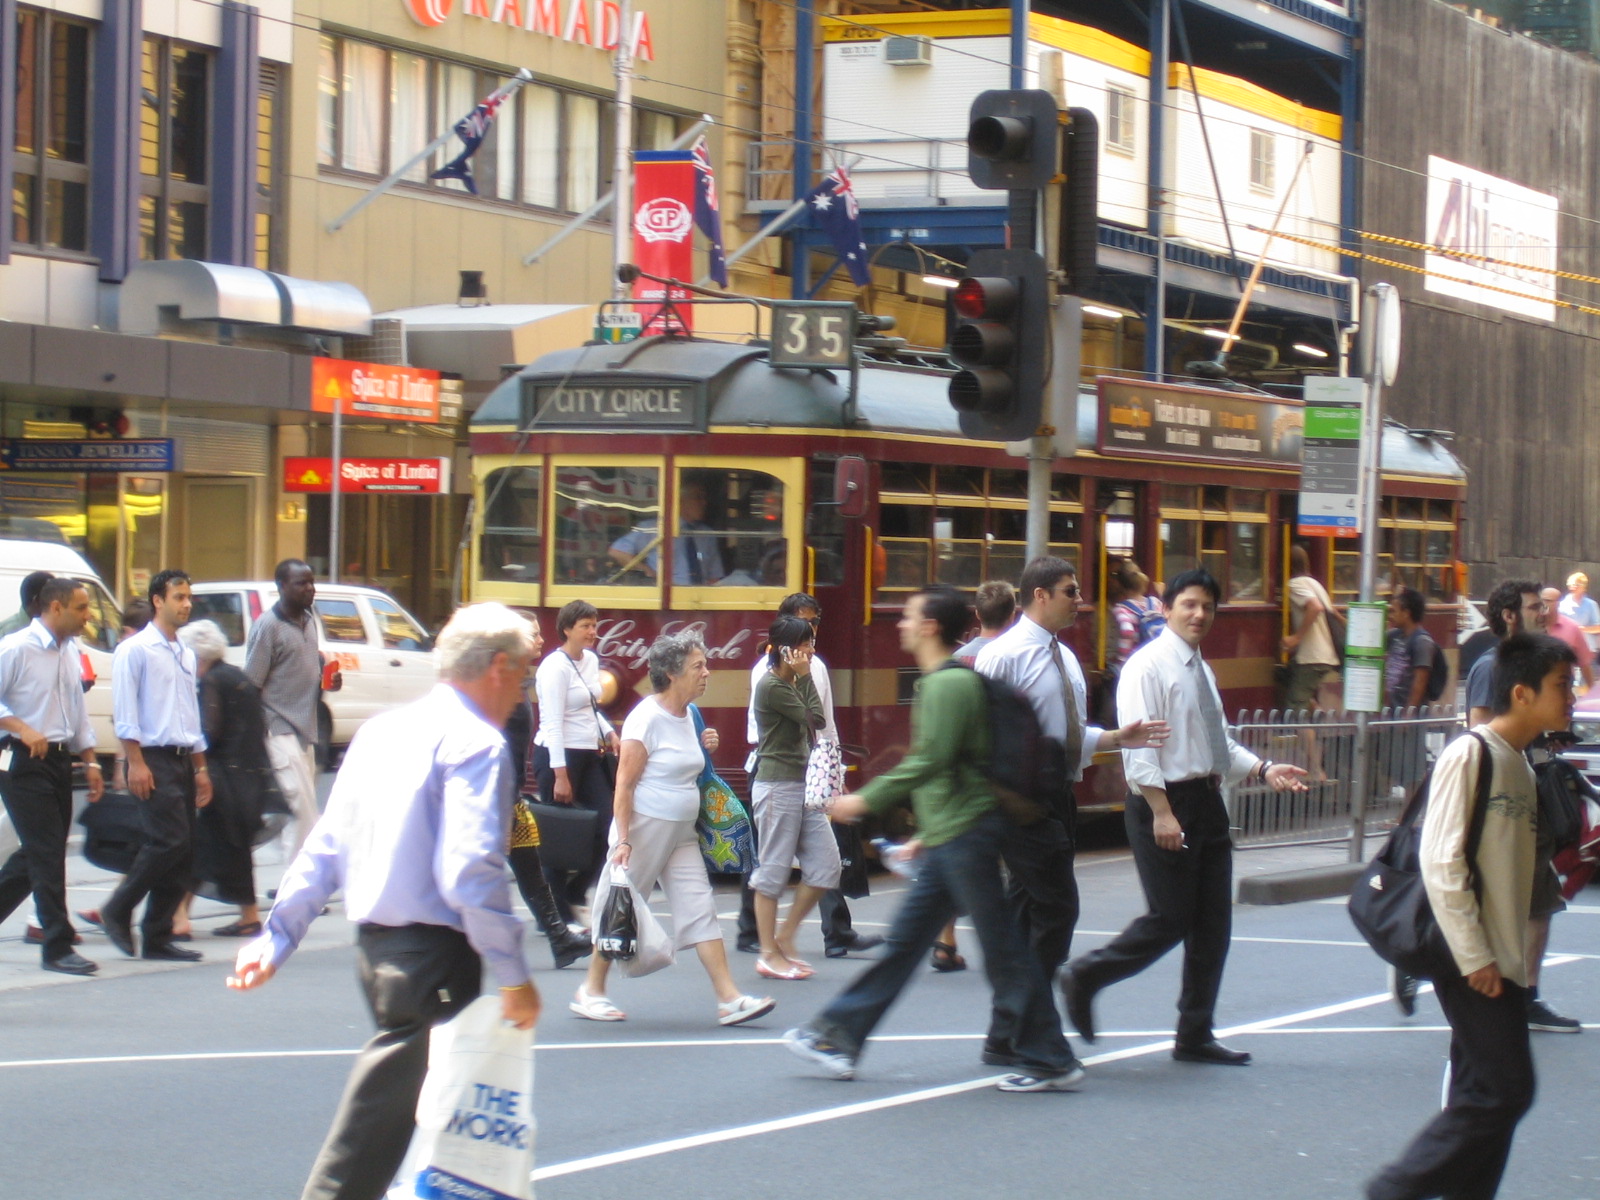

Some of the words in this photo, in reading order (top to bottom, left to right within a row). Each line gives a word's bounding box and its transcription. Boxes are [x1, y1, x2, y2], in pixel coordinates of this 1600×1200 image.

[649, 209, 678, 228] GP
[640, 289, 671, 299] MARC
[555, 389, 605, 413] CITY
[611, 388, 682, 413] CIRCLE
[341, 462, 380, 482] Spice
[398, 462, 438, 480] India
[660, 620, 751, 660] Ccle
[473, 1083, 522, 1117] THE
[443, 1108, 529, 1151] WORK
